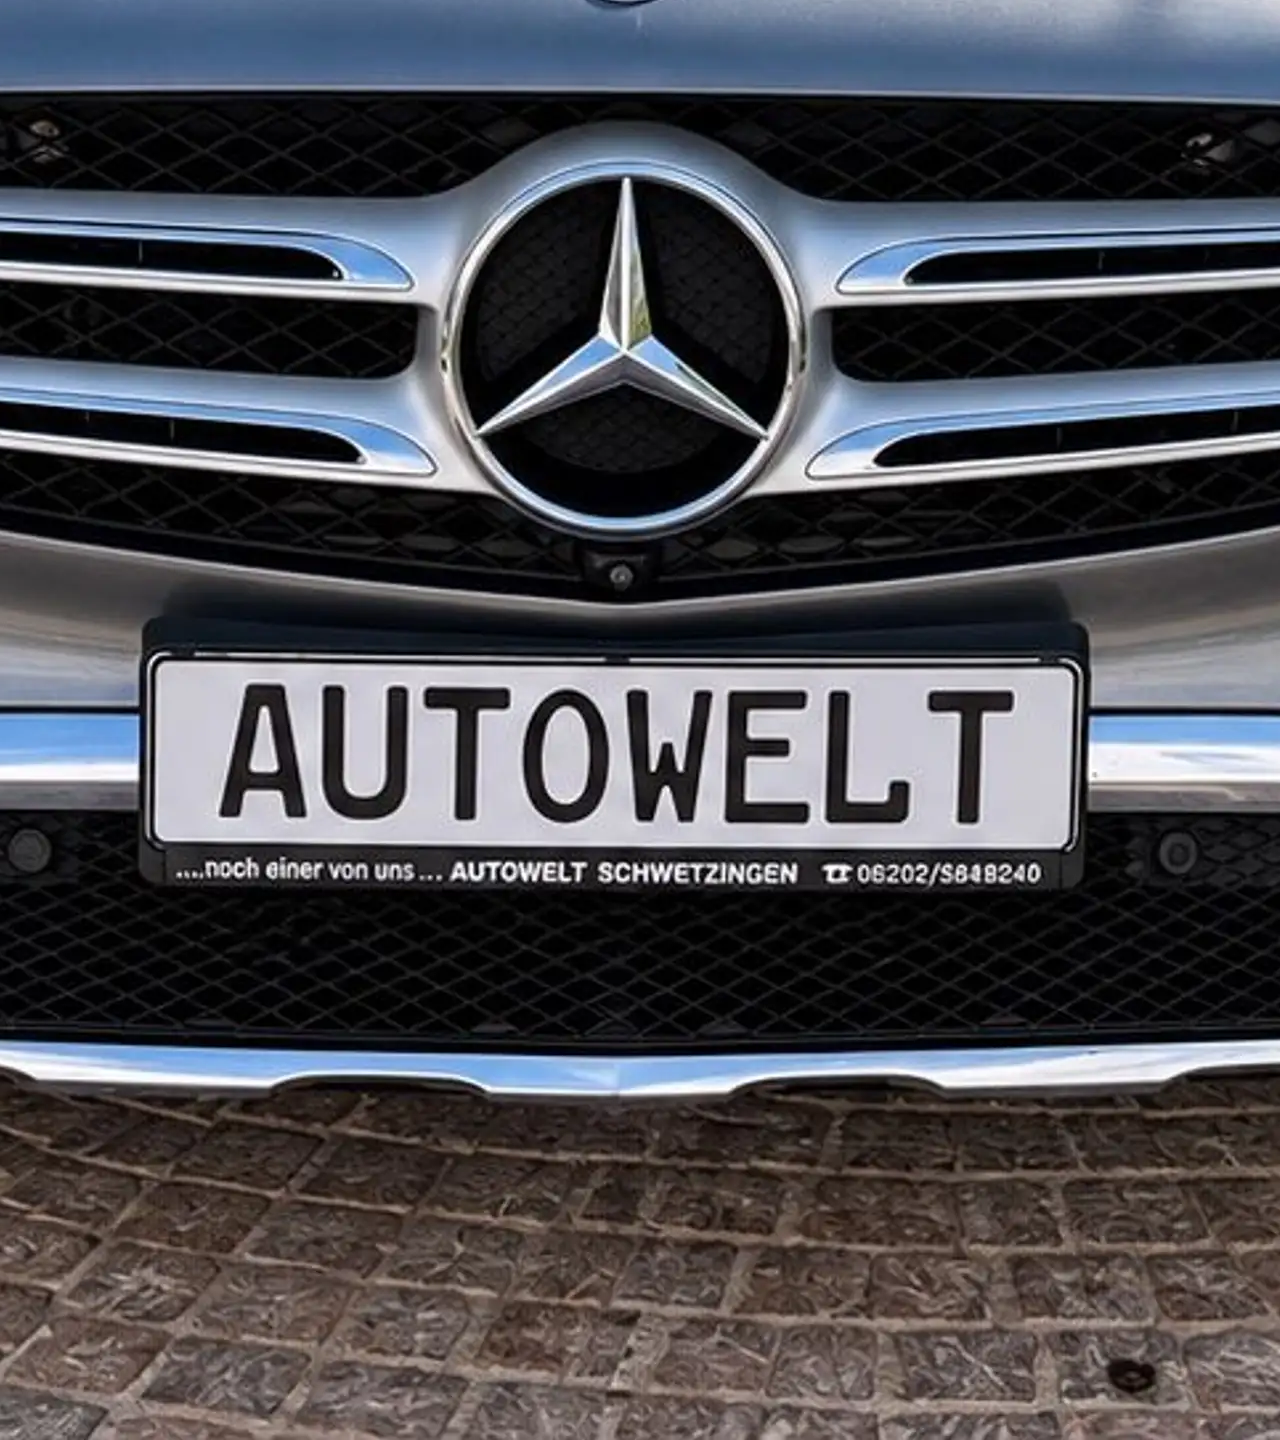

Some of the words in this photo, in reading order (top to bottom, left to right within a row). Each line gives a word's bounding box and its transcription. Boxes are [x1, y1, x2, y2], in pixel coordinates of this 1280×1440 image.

[219, 682, 1015, 825] AUTOWELT
[265, 856, 324, 880] einer
[328, 861, 370, 880] von
[449, 860, 588, 883] AUTOWELT
[597, 861, 799, 885] SCHWETZINGEN
